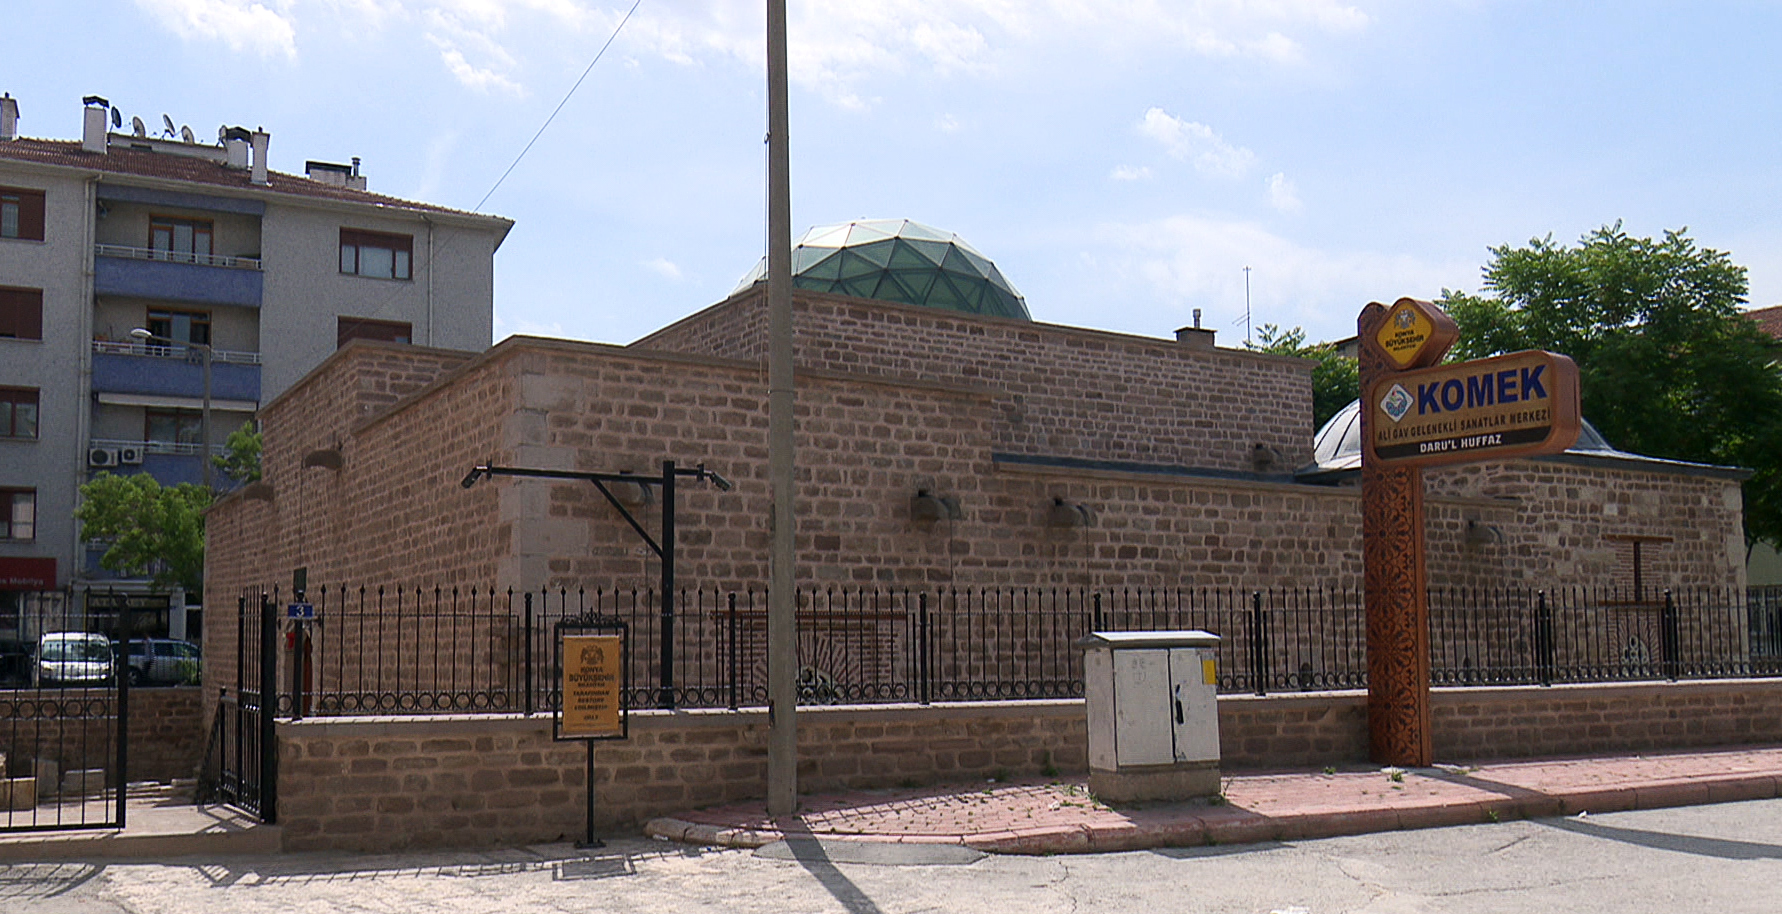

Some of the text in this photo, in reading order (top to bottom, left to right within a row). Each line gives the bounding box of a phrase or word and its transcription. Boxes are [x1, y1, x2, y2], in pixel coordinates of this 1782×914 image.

[1417, 365, 1548, 415] KOMEK
[1378, 430, 1391, 441] ALİ
[1411, 417, 1457, 437] GELENEKLİ
[1460, 415, 1506, 431] SANATLAR
[1509, 407, 1551, 424] MERKEZİ
[1420, 433, 1502, 454] DARU'L HUFFAZ
[296, 605, 305, 617] 3
